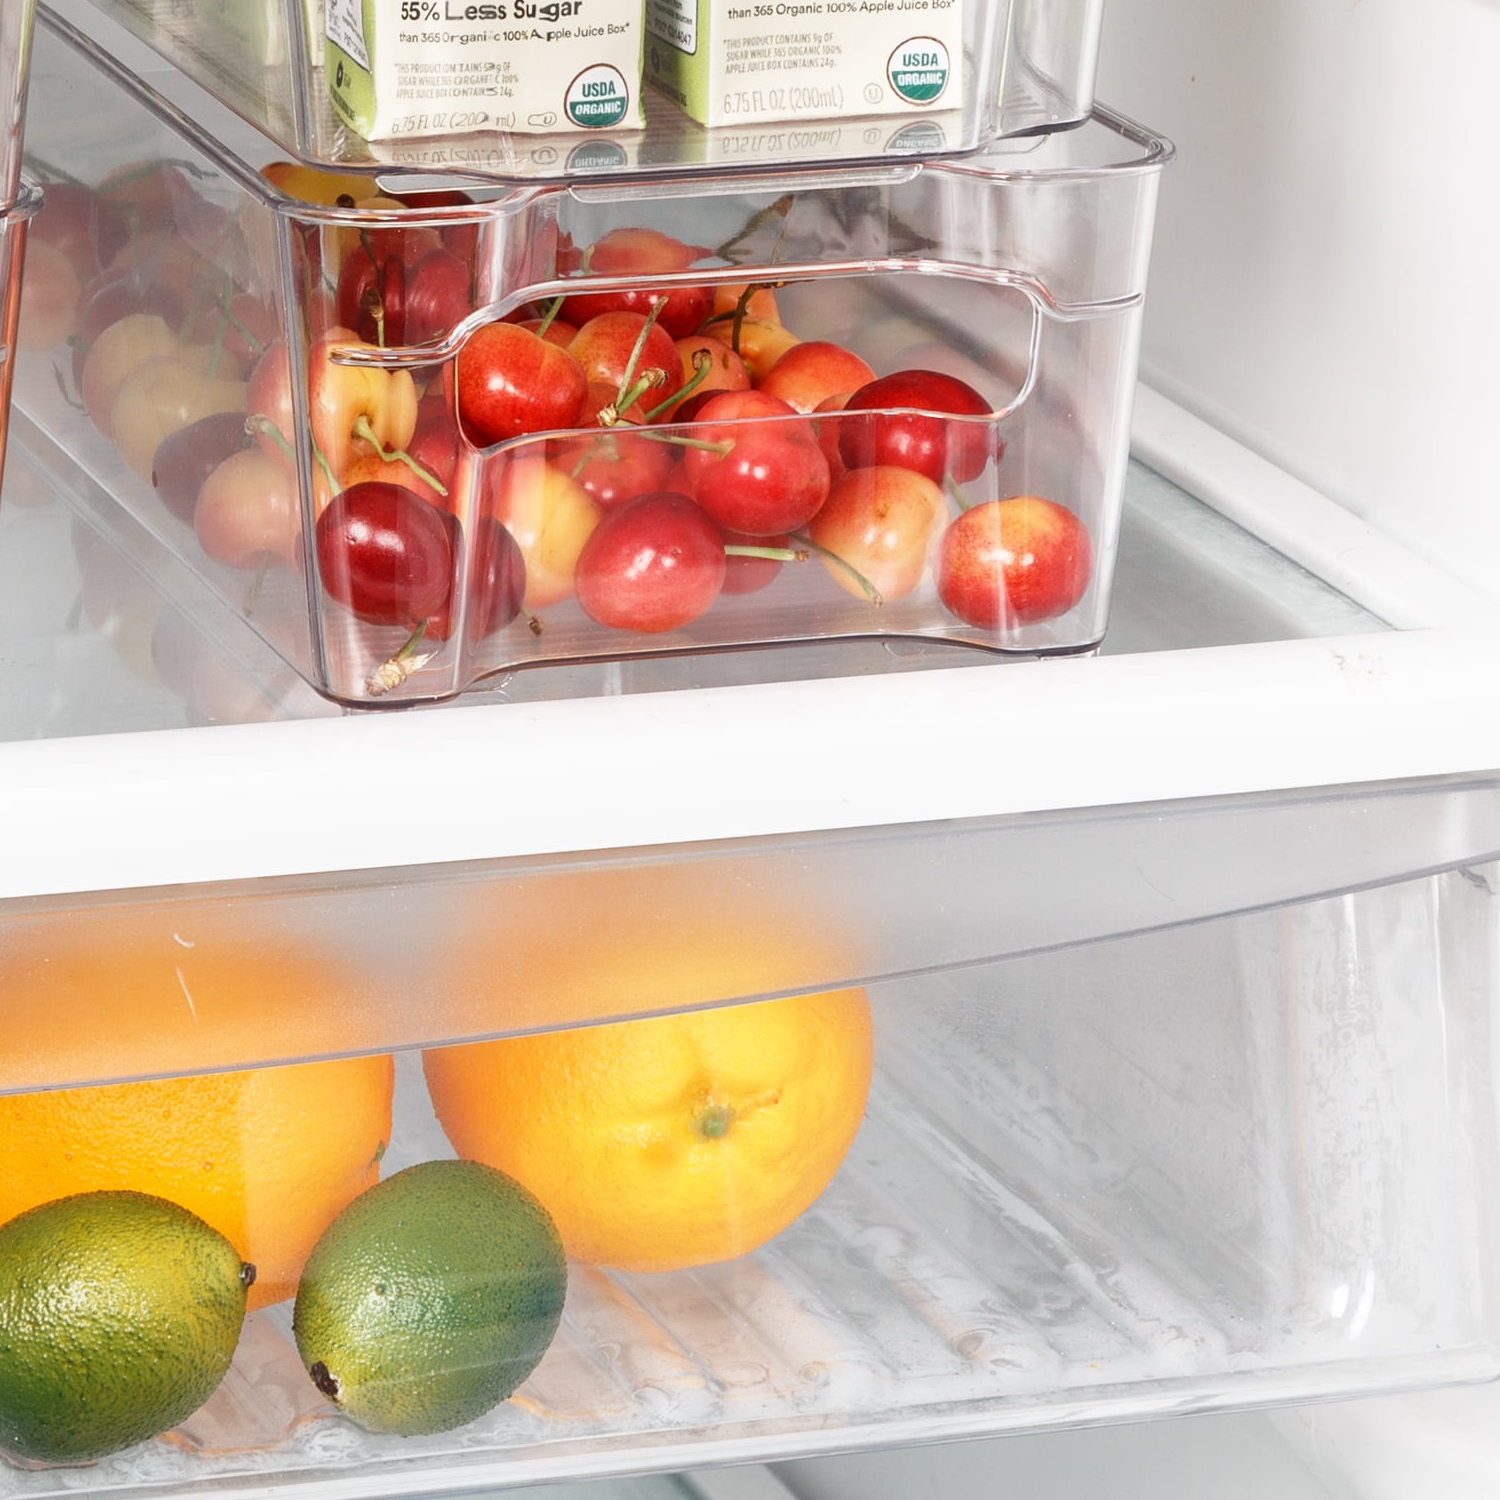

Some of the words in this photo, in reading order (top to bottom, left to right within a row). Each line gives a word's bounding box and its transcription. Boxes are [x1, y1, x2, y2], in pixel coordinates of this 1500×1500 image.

[400, 1, 440, 21] 55%
[445, 0, 507, 21] Less
[728, 7, 752, 20] than
[753, 5, 774, 17] 365
[776, 2, 822, 18] Organic
[826, 2, 857, 14] 100%
[859, 0, 895, 15] Apple
[897, 0, 929, 11] Juice
[399, 32, 418, 43] than
[421, 32, 441, 43] 365
[503, 30, 528, 42] 100%
[530, 27, 572, 42] Apple
[574, 26, 604, 39] Juice
[742, 35, 774, 47] PRODUCT
[775, 33, 811, 45] CONTAINS
[824, 32, 834, 42] OF
[726, 50, 749, 62] SUGAR
[787, 45, 821, 57] ORGANIC
[902, 52, 939, 67] USDA
[725, 62, 745, 75] APPLE
[747, 61, 765, 73] JUICE
[767, 59, 781, 71] BOX
[783, 58, 819, 70] CONTAINS
[897, 71, 943, 86] ORGANIC
[582, 80, 616, 98] USDA
[723, 91, 750, 114] 6.75
[752, 90, 768, 112] FL
[770, 88, 787, 110] OZ
[789, 84, 844, 112] (200mL)
[574, 101, 622, 115] ORGANIC
[391, 113, 417, 134] 6.75
[418, 113, 429, 130] FL
[432, 112, 447, 128] OZ
